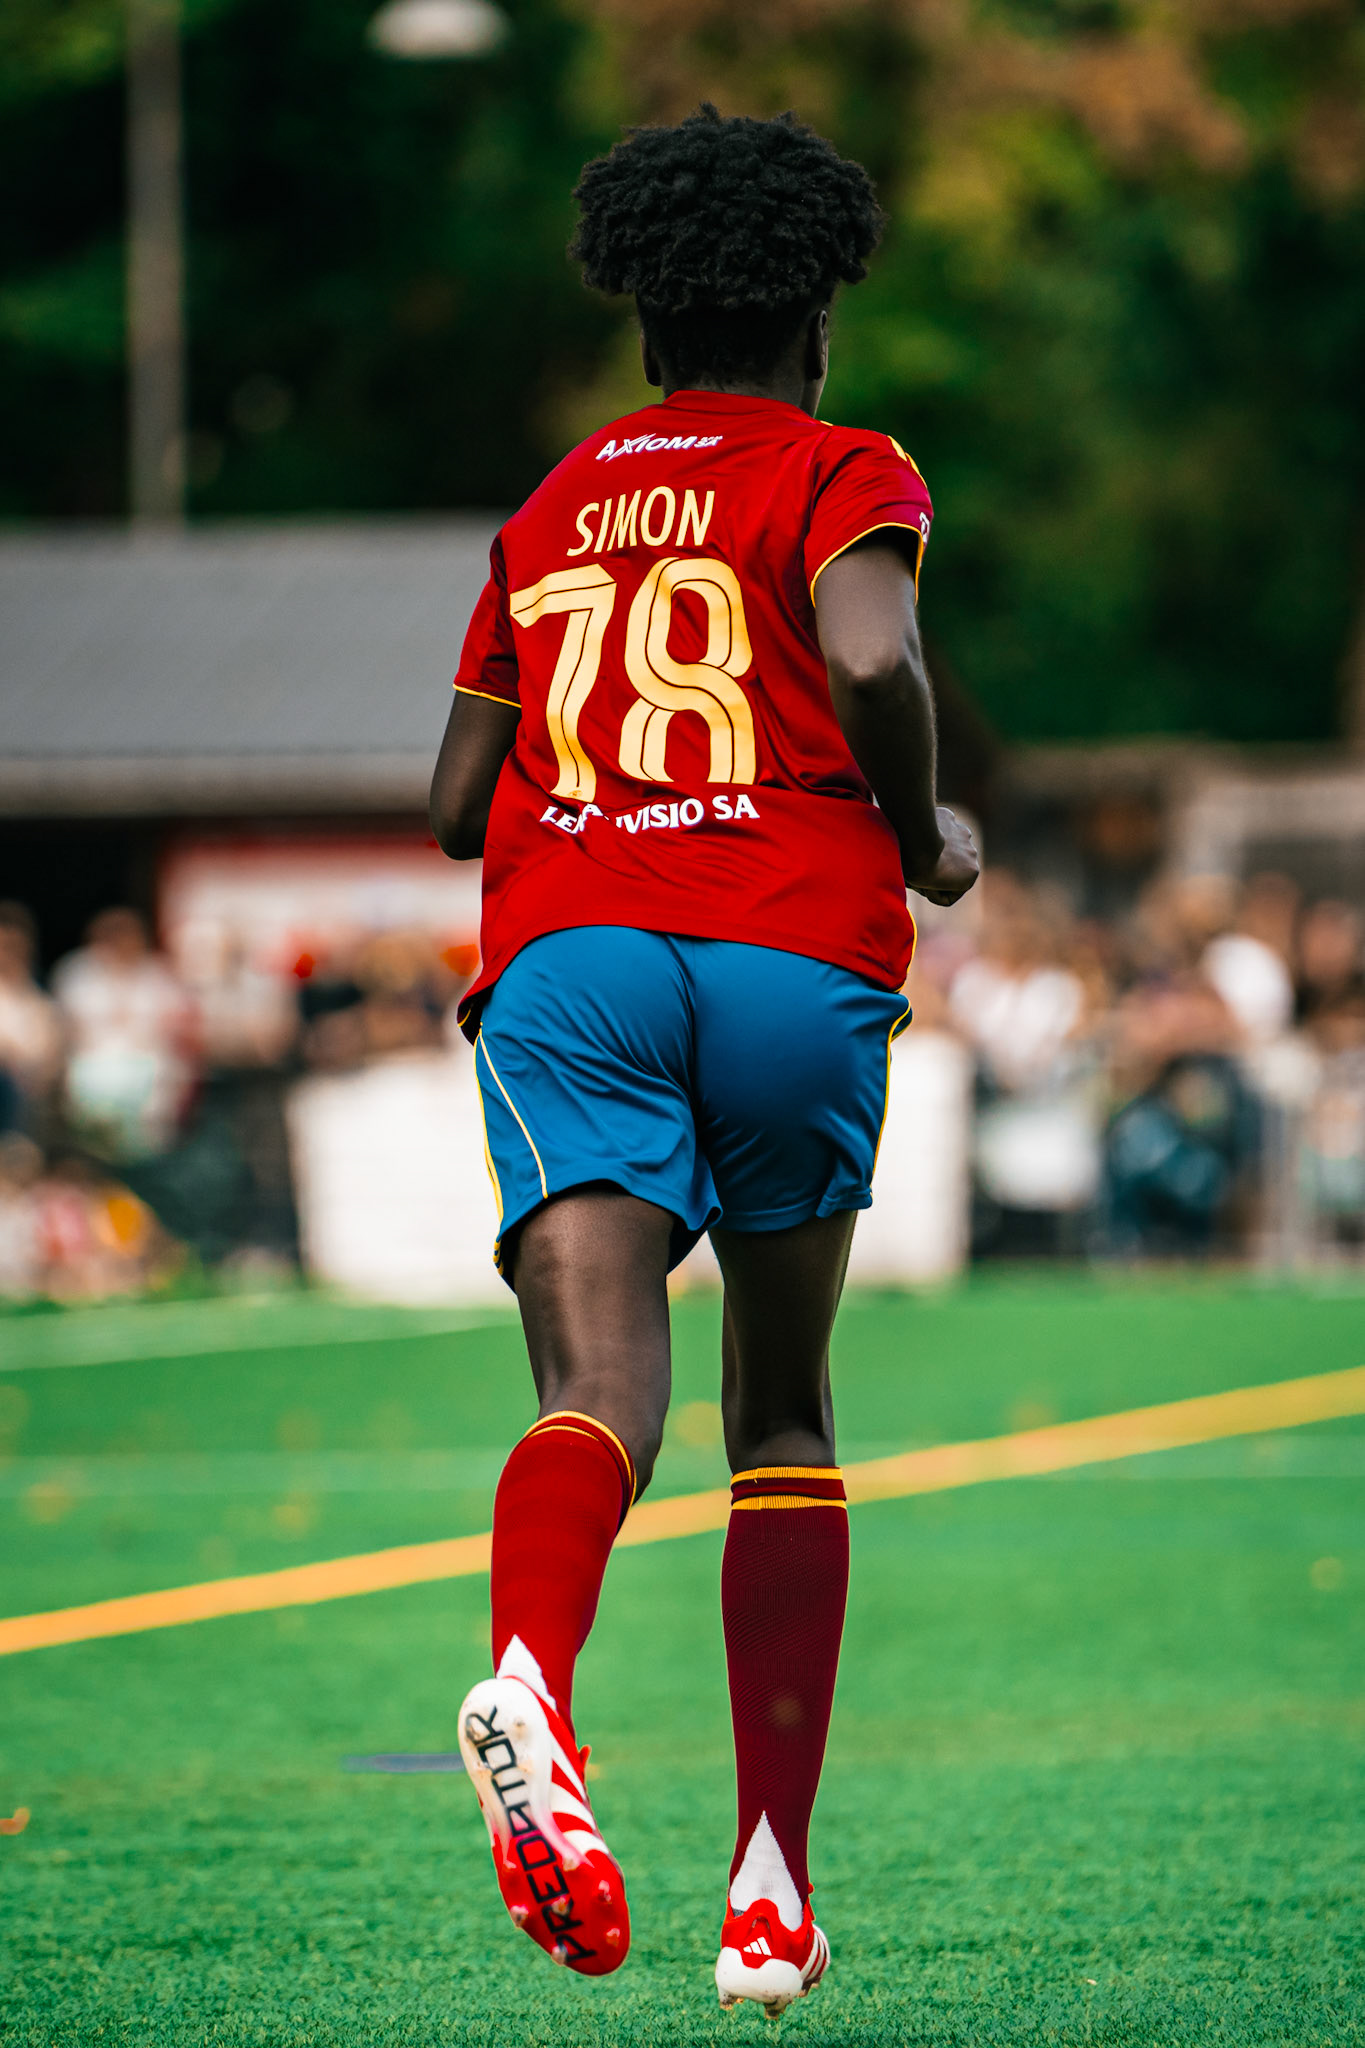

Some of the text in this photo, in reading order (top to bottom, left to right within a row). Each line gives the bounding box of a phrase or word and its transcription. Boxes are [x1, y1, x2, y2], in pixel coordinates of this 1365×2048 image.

[595, 433, 698, 463] AXIOM
[566, 485, 715, 557] SIMON
[510, 557, 757, 803] 78
[712, 794, 760, 820] SA
[465, 1705, 596, 1964] PREDATOR
